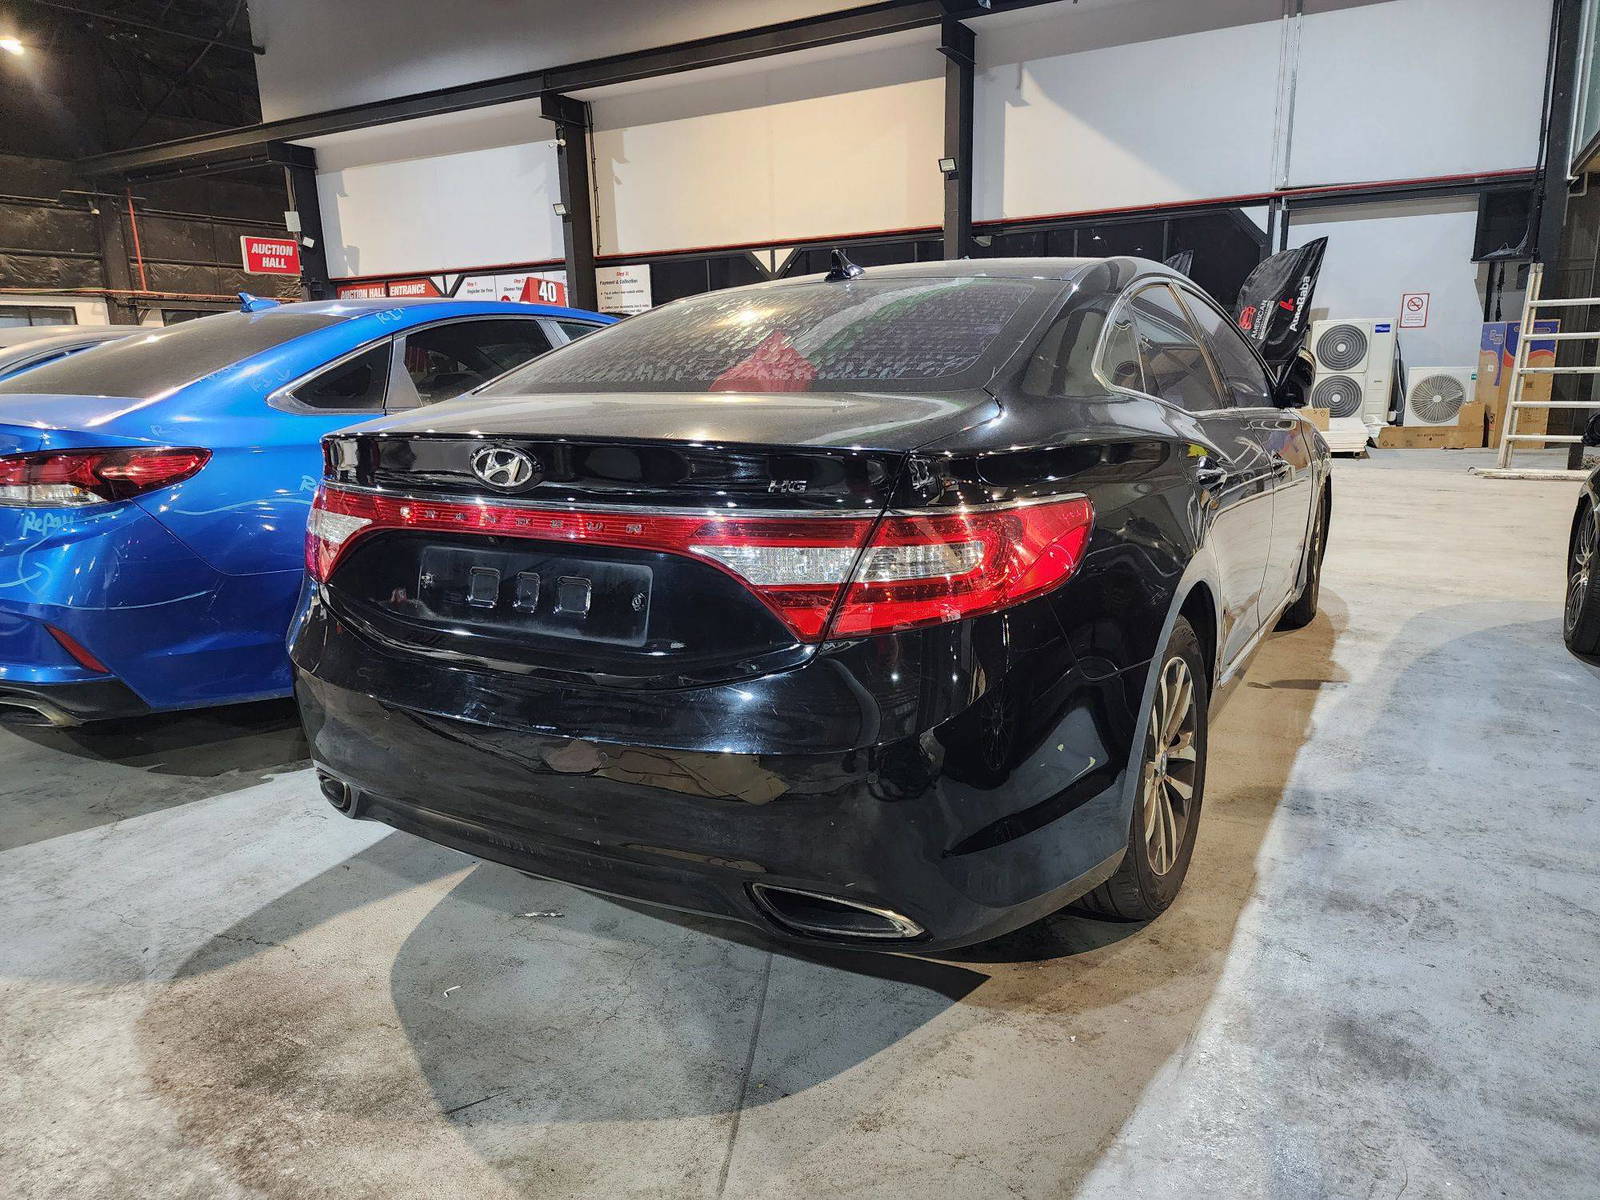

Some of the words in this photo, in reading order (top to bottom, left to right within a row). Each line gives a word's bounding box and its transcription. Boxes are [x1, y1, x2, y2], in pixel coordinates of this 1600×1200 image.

[251, 242, 294, 257] AUCTION
[262, 256, 287, 269] HALL
[341, 288, 368, 301] AUCTION
[368, 287, 386, 298] HALL
[389, 283, 426, 297] ENTRANCE
[538, 280, 557, 302] 40
[1251, 299, 1268, 339] AMERICAN
[767, 479, 808, 494] HG
